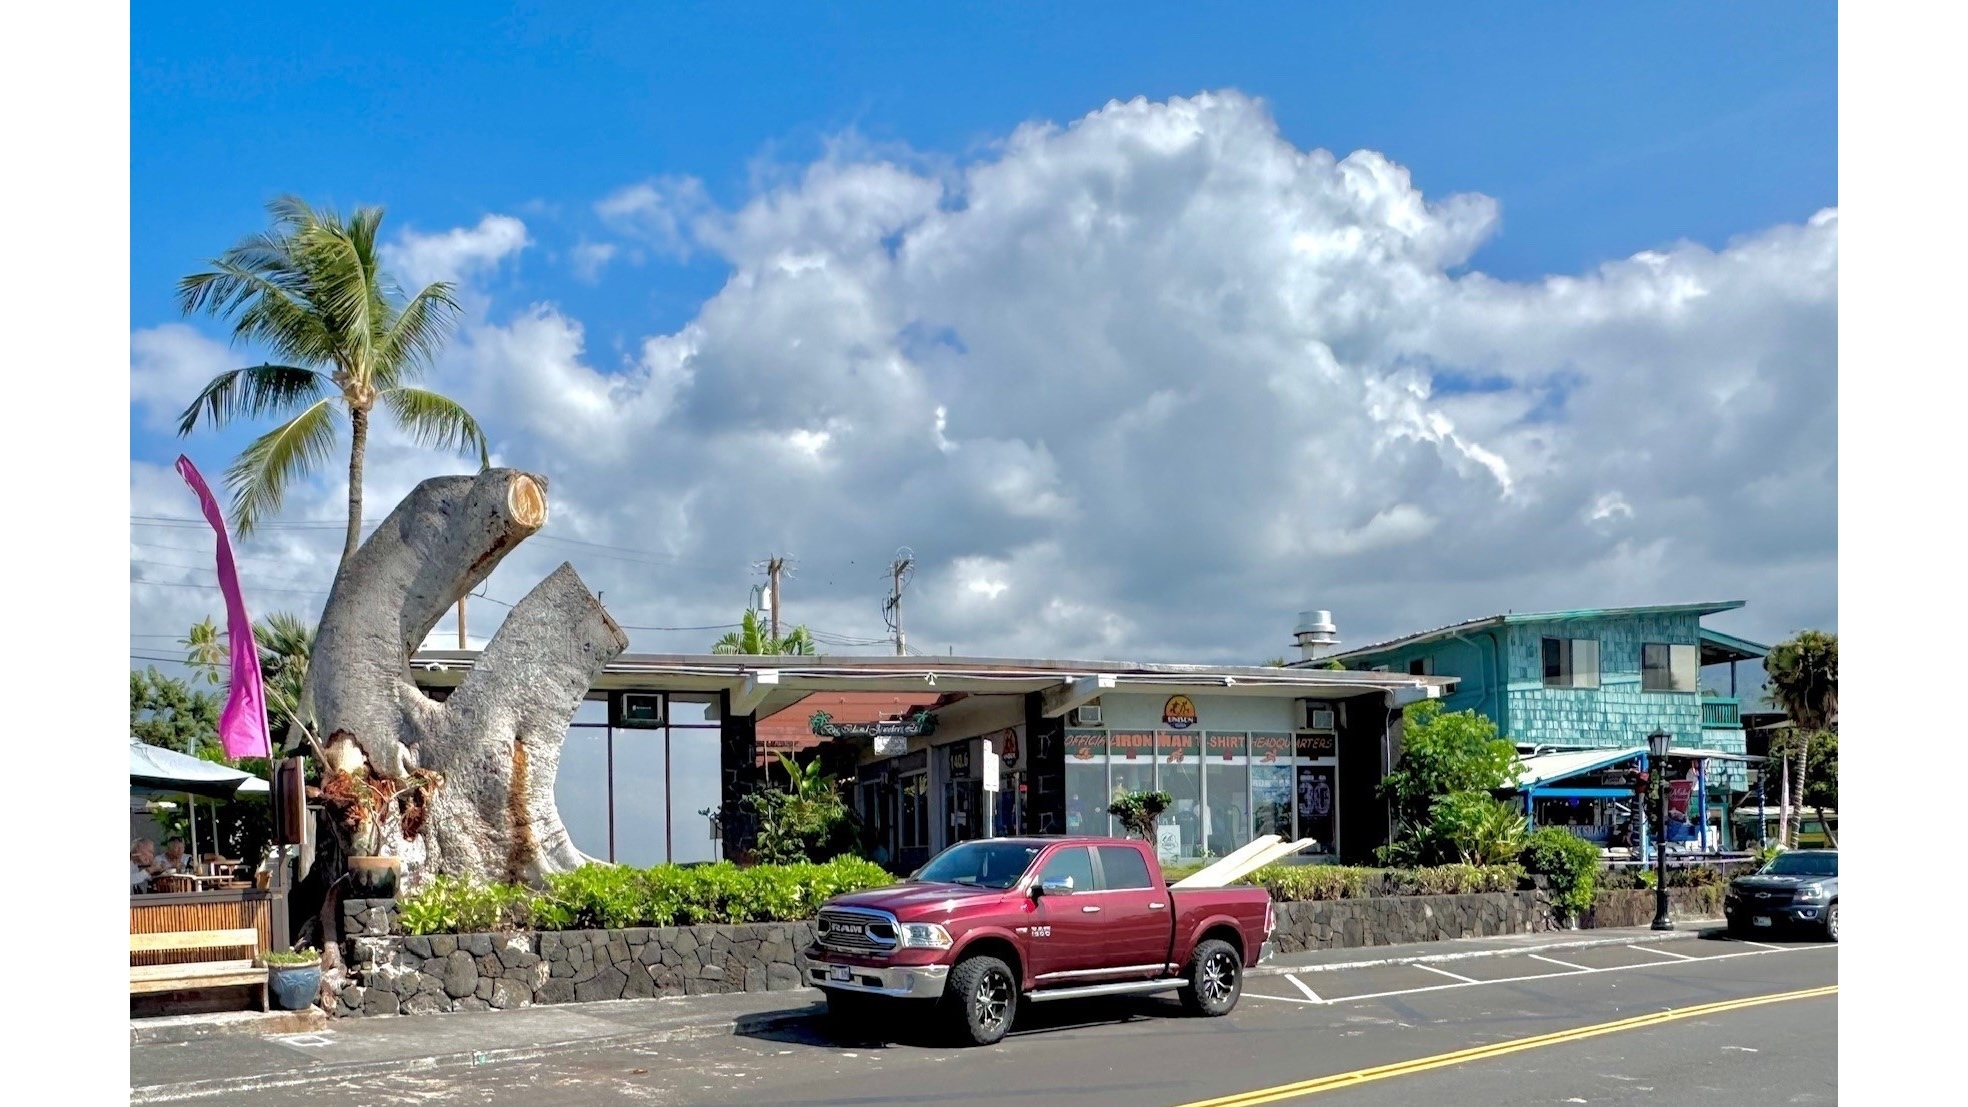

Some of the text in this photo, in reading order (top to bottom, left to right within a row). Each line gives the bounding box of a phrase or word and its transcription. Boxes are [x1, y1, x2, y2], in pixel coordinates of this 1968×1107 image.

[1115, 734, 1153, 747] IRON
[950, 752, 969, 770] 140.6
[831, 922, 863, 934] RAM
